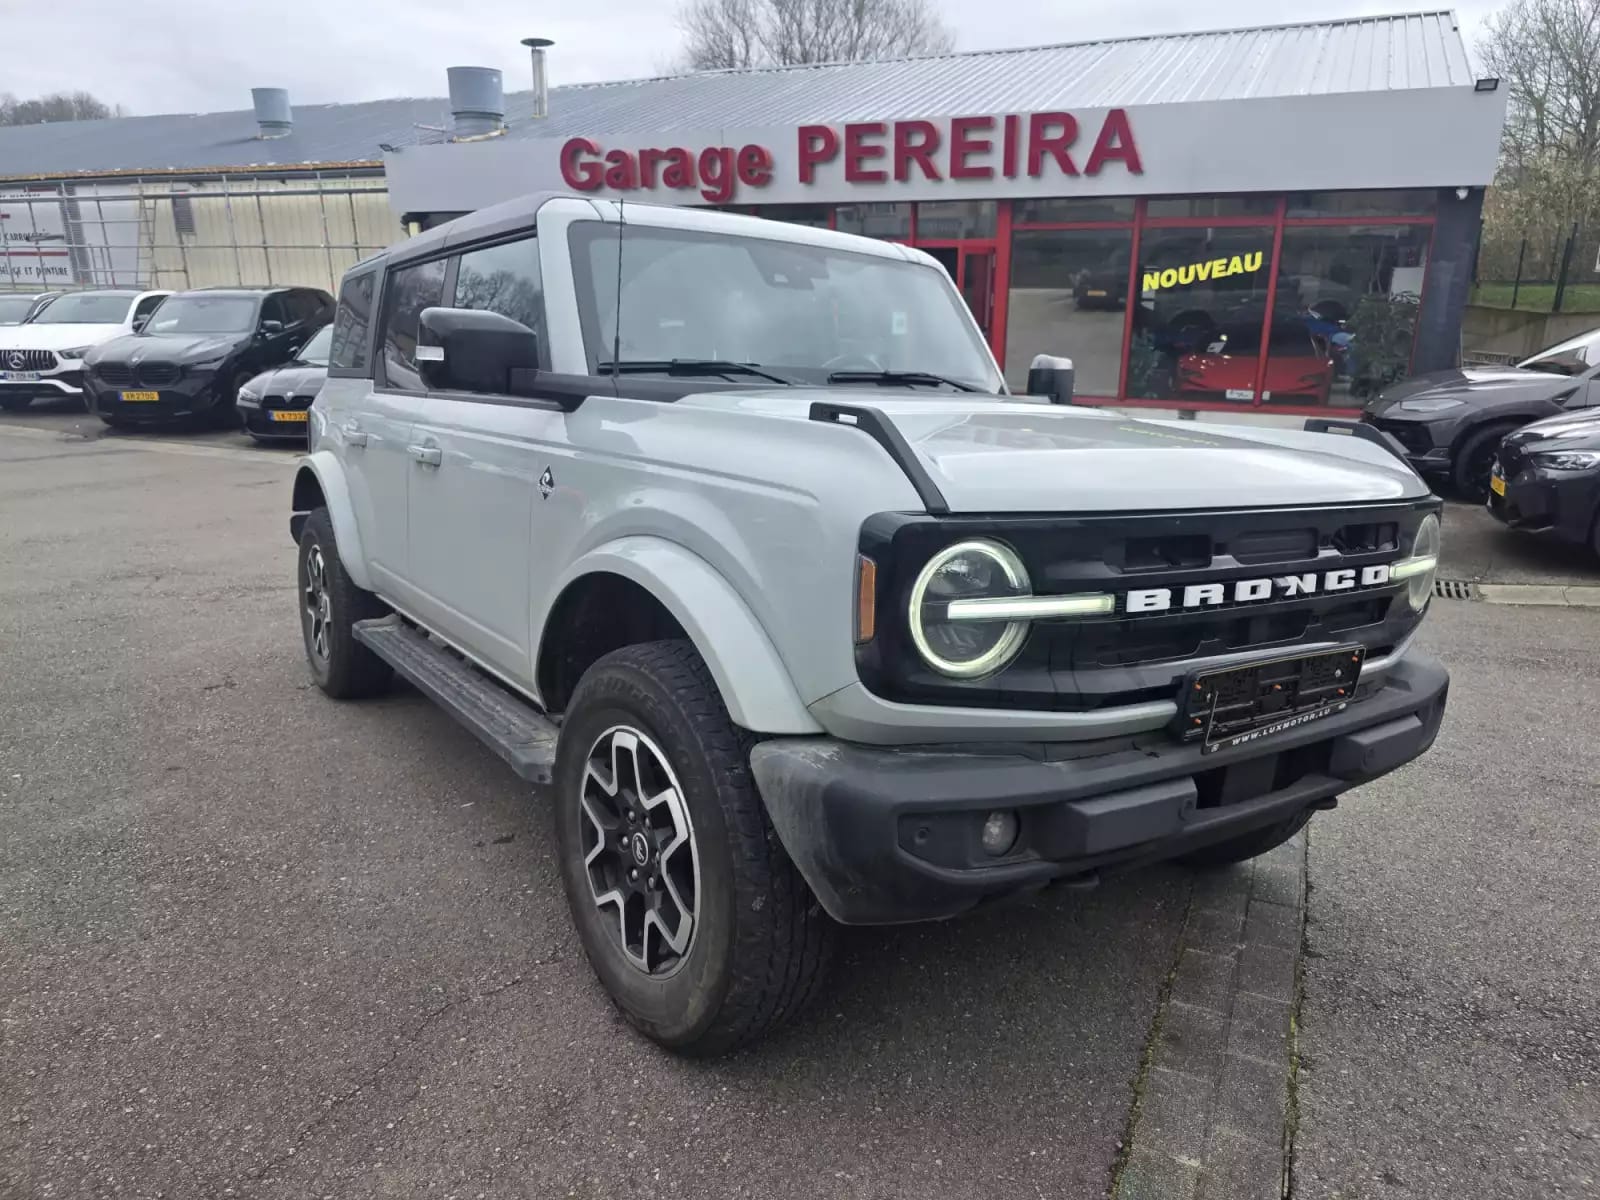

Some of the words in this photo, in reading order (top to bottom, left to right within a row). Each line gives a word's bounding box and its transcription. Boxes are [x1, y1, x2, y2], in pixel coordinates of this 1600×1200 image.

[559, 137, 773, 202] Garage
[798, 108, 1144, 186] PEREIRA
[1142, 251, 1263, 292] NOUVEAU
[1126, 565, 1390, 613] BRONCO
[1231, 708, 1331, 746] WWW.LUXMOTOR.LU
